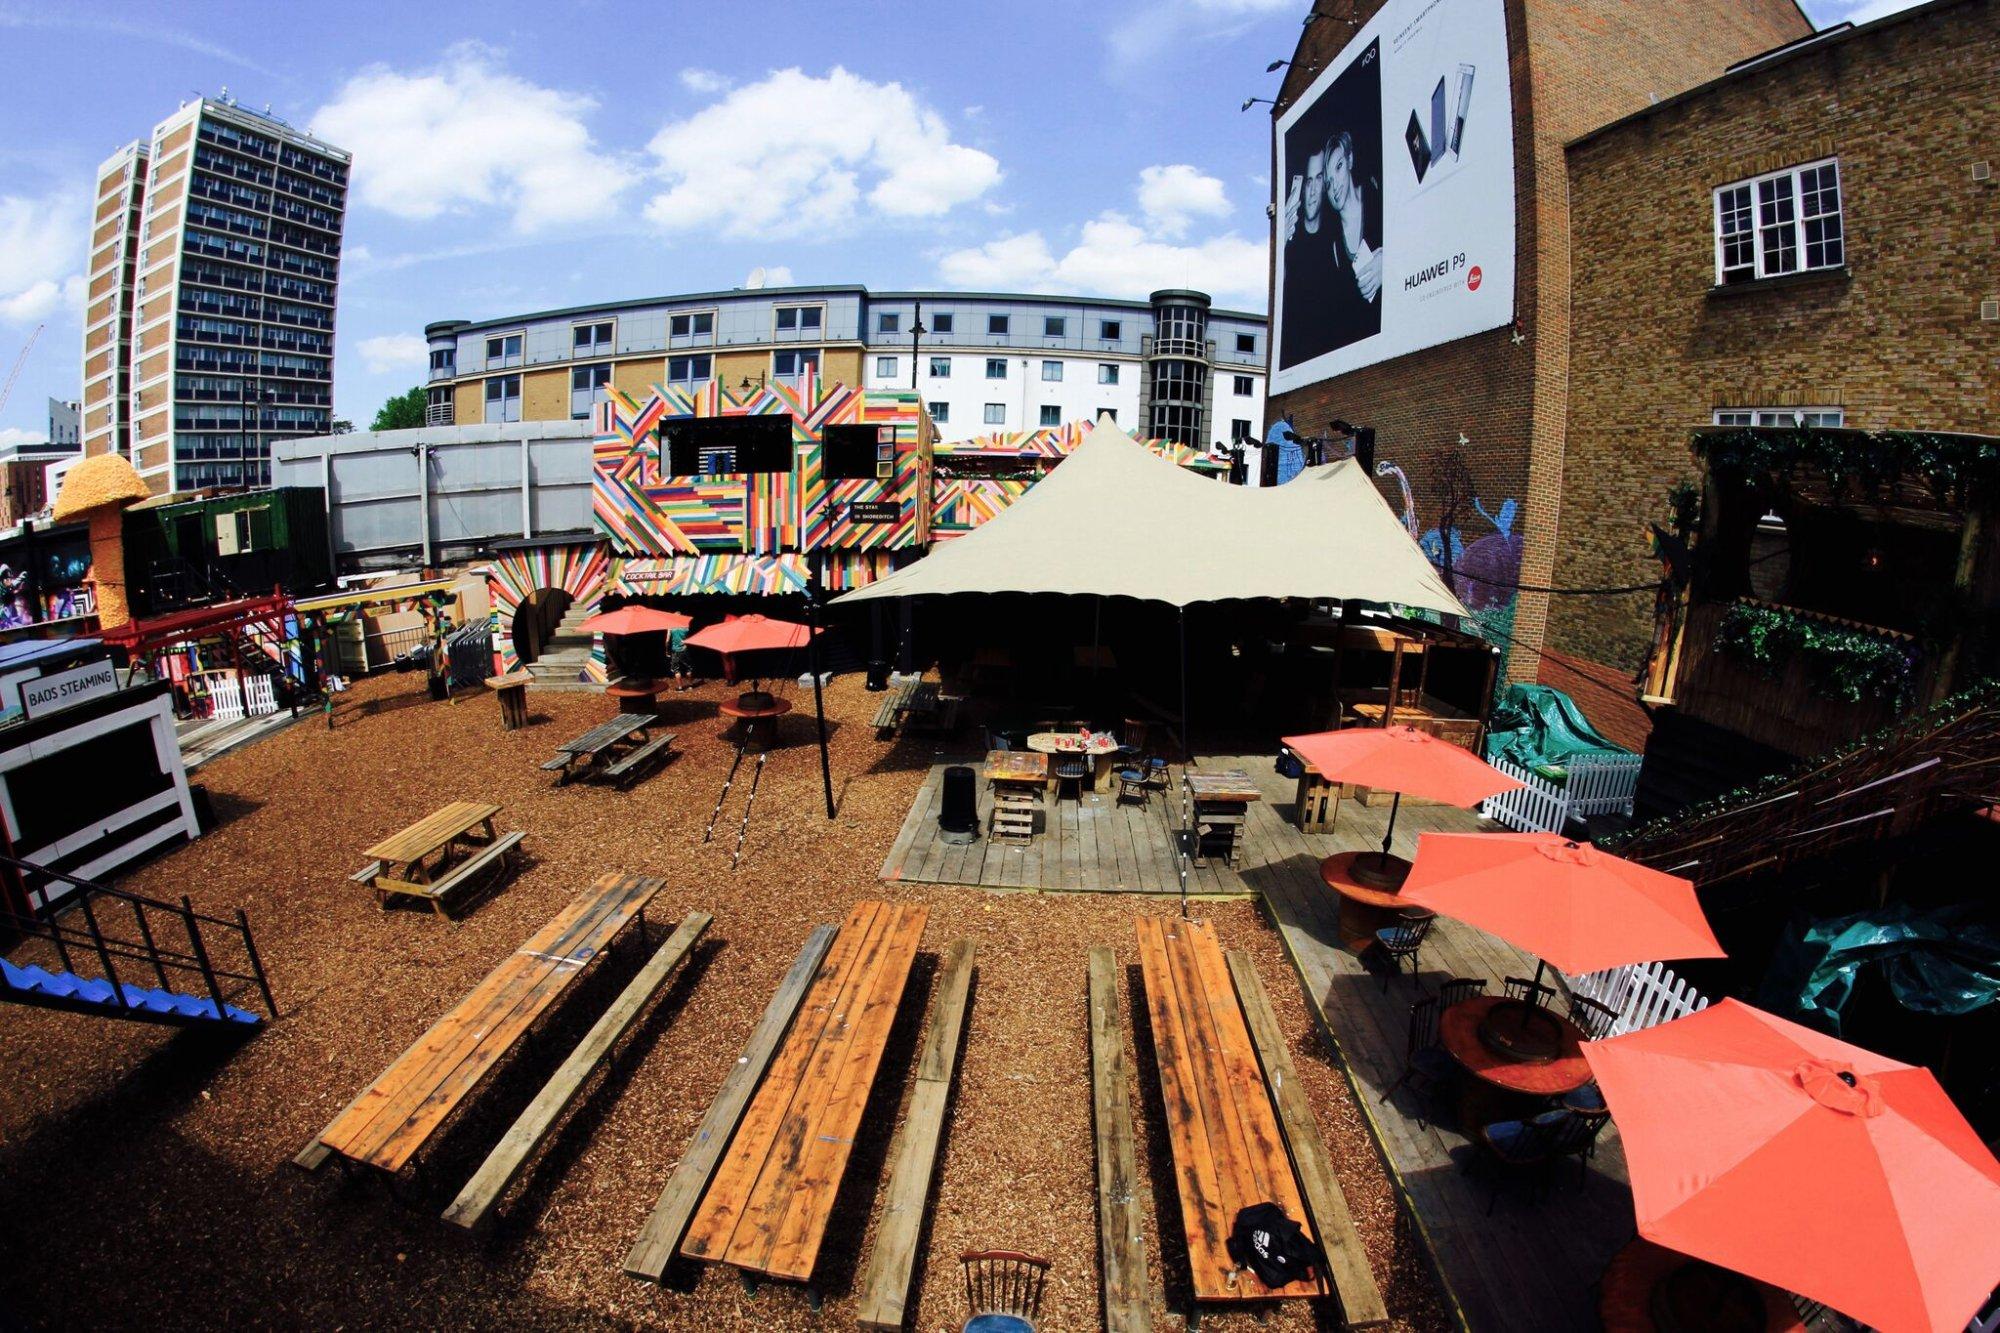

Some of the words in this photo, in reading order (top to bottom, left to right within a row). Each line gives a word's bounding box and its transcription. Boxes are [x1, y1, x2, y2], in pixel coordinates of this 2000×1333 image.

[1404, 260, 1449, 291] HUAWEI
[1452, 252, 1466, 271] P9
[28, 687, 59, 707] BAOS
[60, 671, 112, 697] STEAMING
